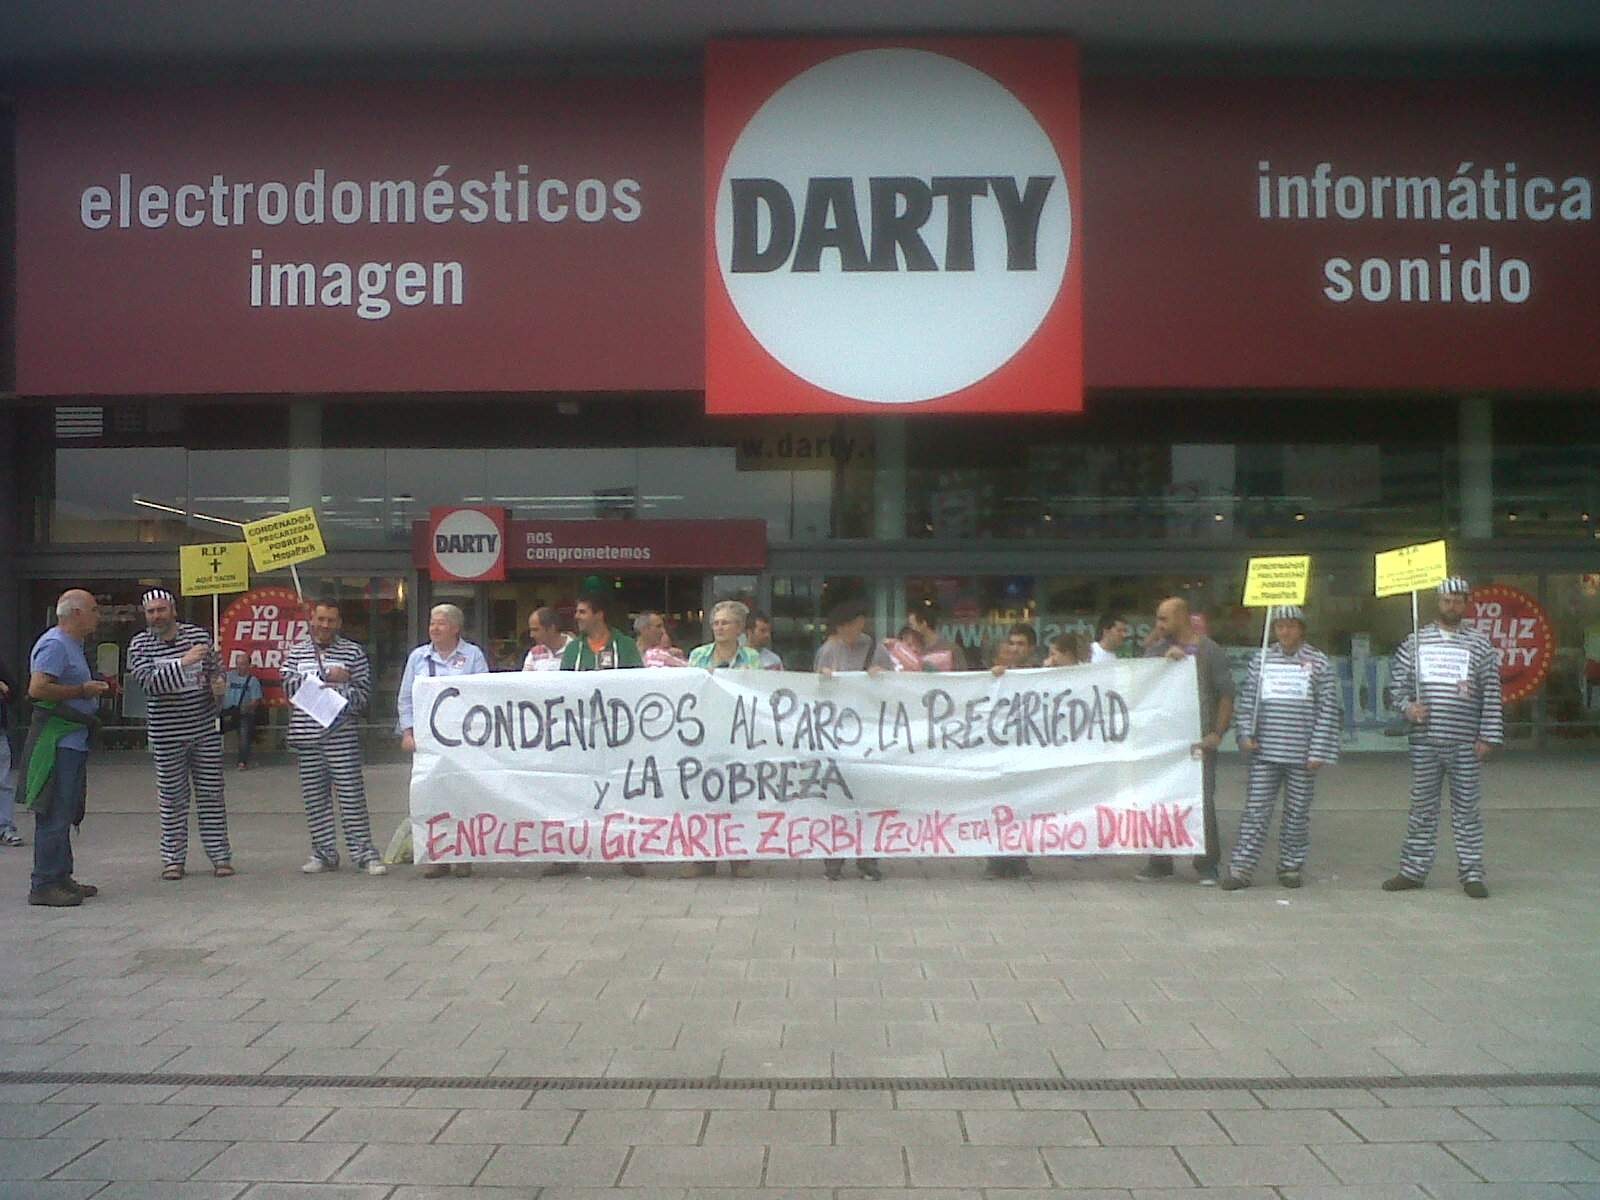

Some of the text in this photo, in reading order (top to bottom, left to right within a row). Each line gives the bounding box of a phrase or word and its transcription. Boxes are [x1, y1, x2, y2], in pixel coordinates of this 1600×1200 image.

[80, 164, 642, 229] electrodomésticos
[1258, 160, 1592, 221] informática
[730, 175, 1056, 273] DARTY
[250, 248, 464, 319] imagen
[1323, 243, 1531, 303] sonido
[248, 513, 311, 536] CONDENADOS
[269, 534, 310, 550] POBREZA
[435, 533, 499, 554] DARTY
[526, 532, 553, 545] nos
[526, 547, 652, 563] comprometemos
[251, 605, 279, 620] YO
[1474, 603, 1502, 617] YO
[235, 620, 311, 641] FELIZ
[430, 687, 705, 751] CONDENAD@S
[731, 694, 767, 750] AL
[769, 687, 873, 757] PARO,
[878, 700, 915, 753] LA
[623, 755, 665, 801] LA
[677, 756, 853, 804] POBREZA
